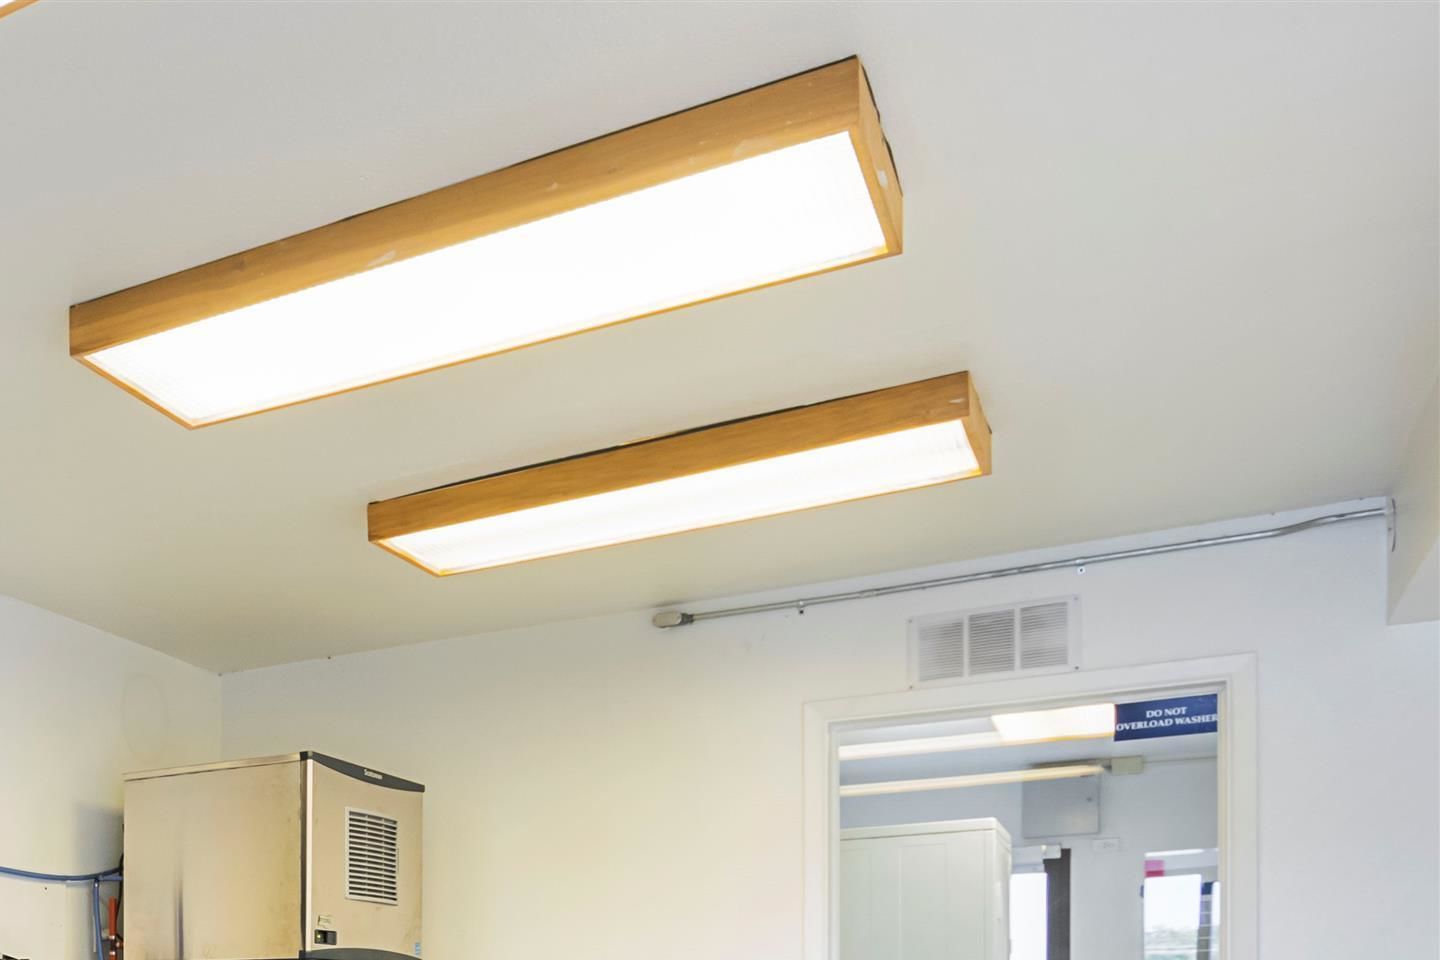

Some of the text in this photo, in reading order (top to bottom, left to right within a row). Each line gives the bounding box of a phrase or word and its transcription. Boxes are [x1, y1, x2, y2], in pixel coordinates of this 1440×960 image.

[1145, 706, 1188, 719] DO NOT
[1115, 718, 1174, 732] OVERLOAD
